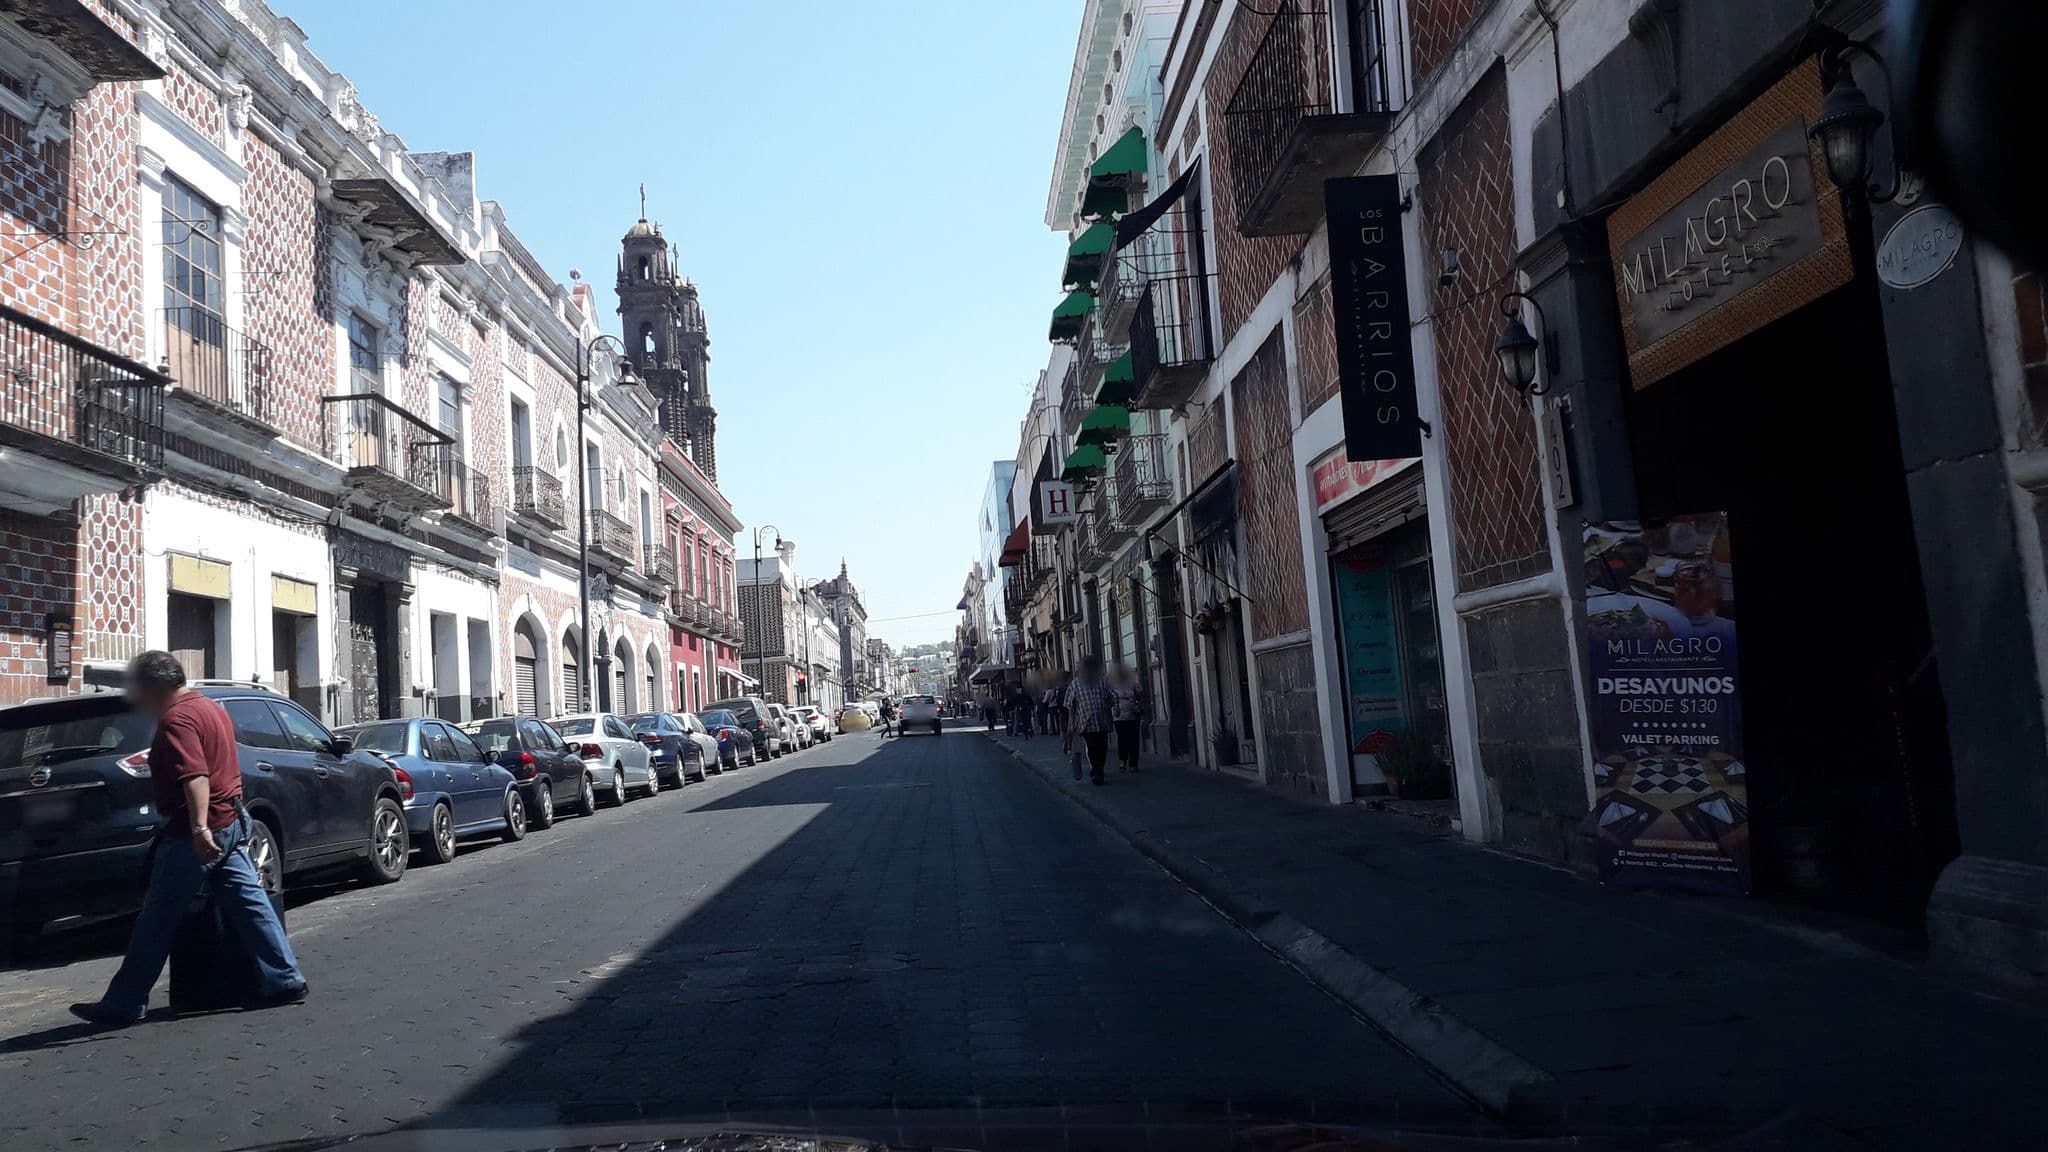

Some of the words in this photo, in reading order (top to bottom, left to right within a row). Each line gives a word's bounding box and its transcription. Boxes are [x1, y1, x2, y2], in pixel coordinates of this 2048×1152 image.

[1360, 208, 1383, 219] LOS
[1622, 156, 1790, 303] MILAGRO
[1882, 220, 1956, 269] MILAGRO
[1361, 226, 1400, 424] BARRIOS
[1048, 489, 1068, 513] H
[1607, 636, 1722, 655] MILAGRO
[1598, 675, 1736, 695] DESAYUNOS
[1619, 699, 1674, 713] DESDE
[1680, 698, 1718, 714] $130
[1622, 734, 1662, 744] VALET
[1665, 735, 1720, 745] PARKING
